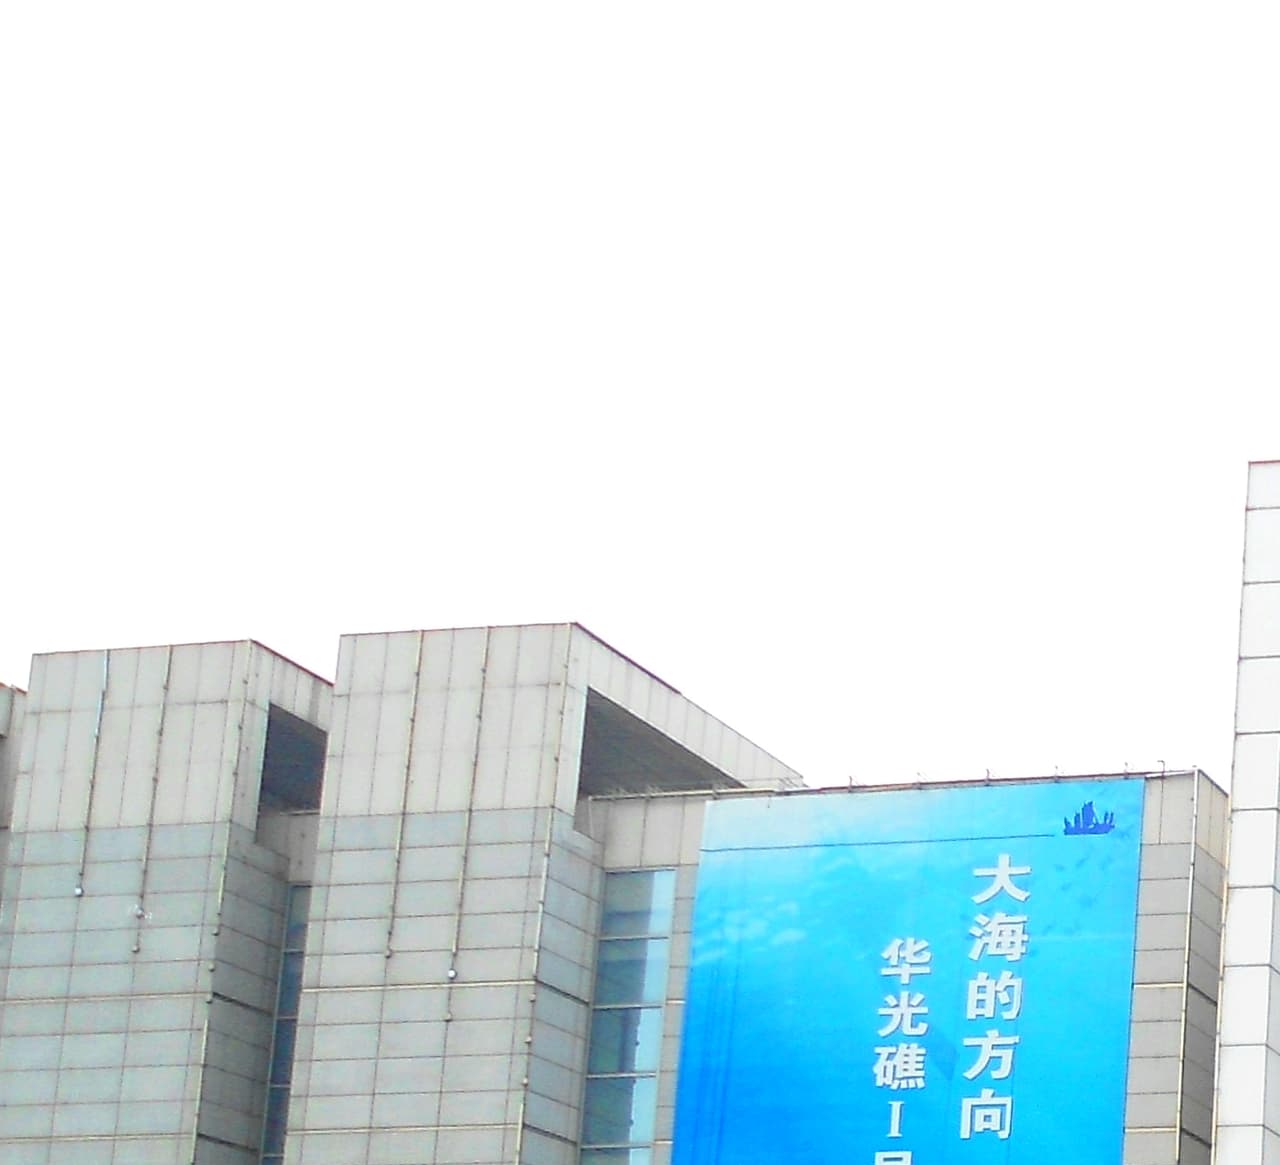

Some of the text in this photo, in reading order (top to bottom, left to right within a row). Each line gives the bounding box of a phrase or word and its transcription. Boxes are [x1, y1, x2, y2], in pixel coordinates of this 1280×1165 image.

[960, 853, 1032, 1140] 大海的方向
